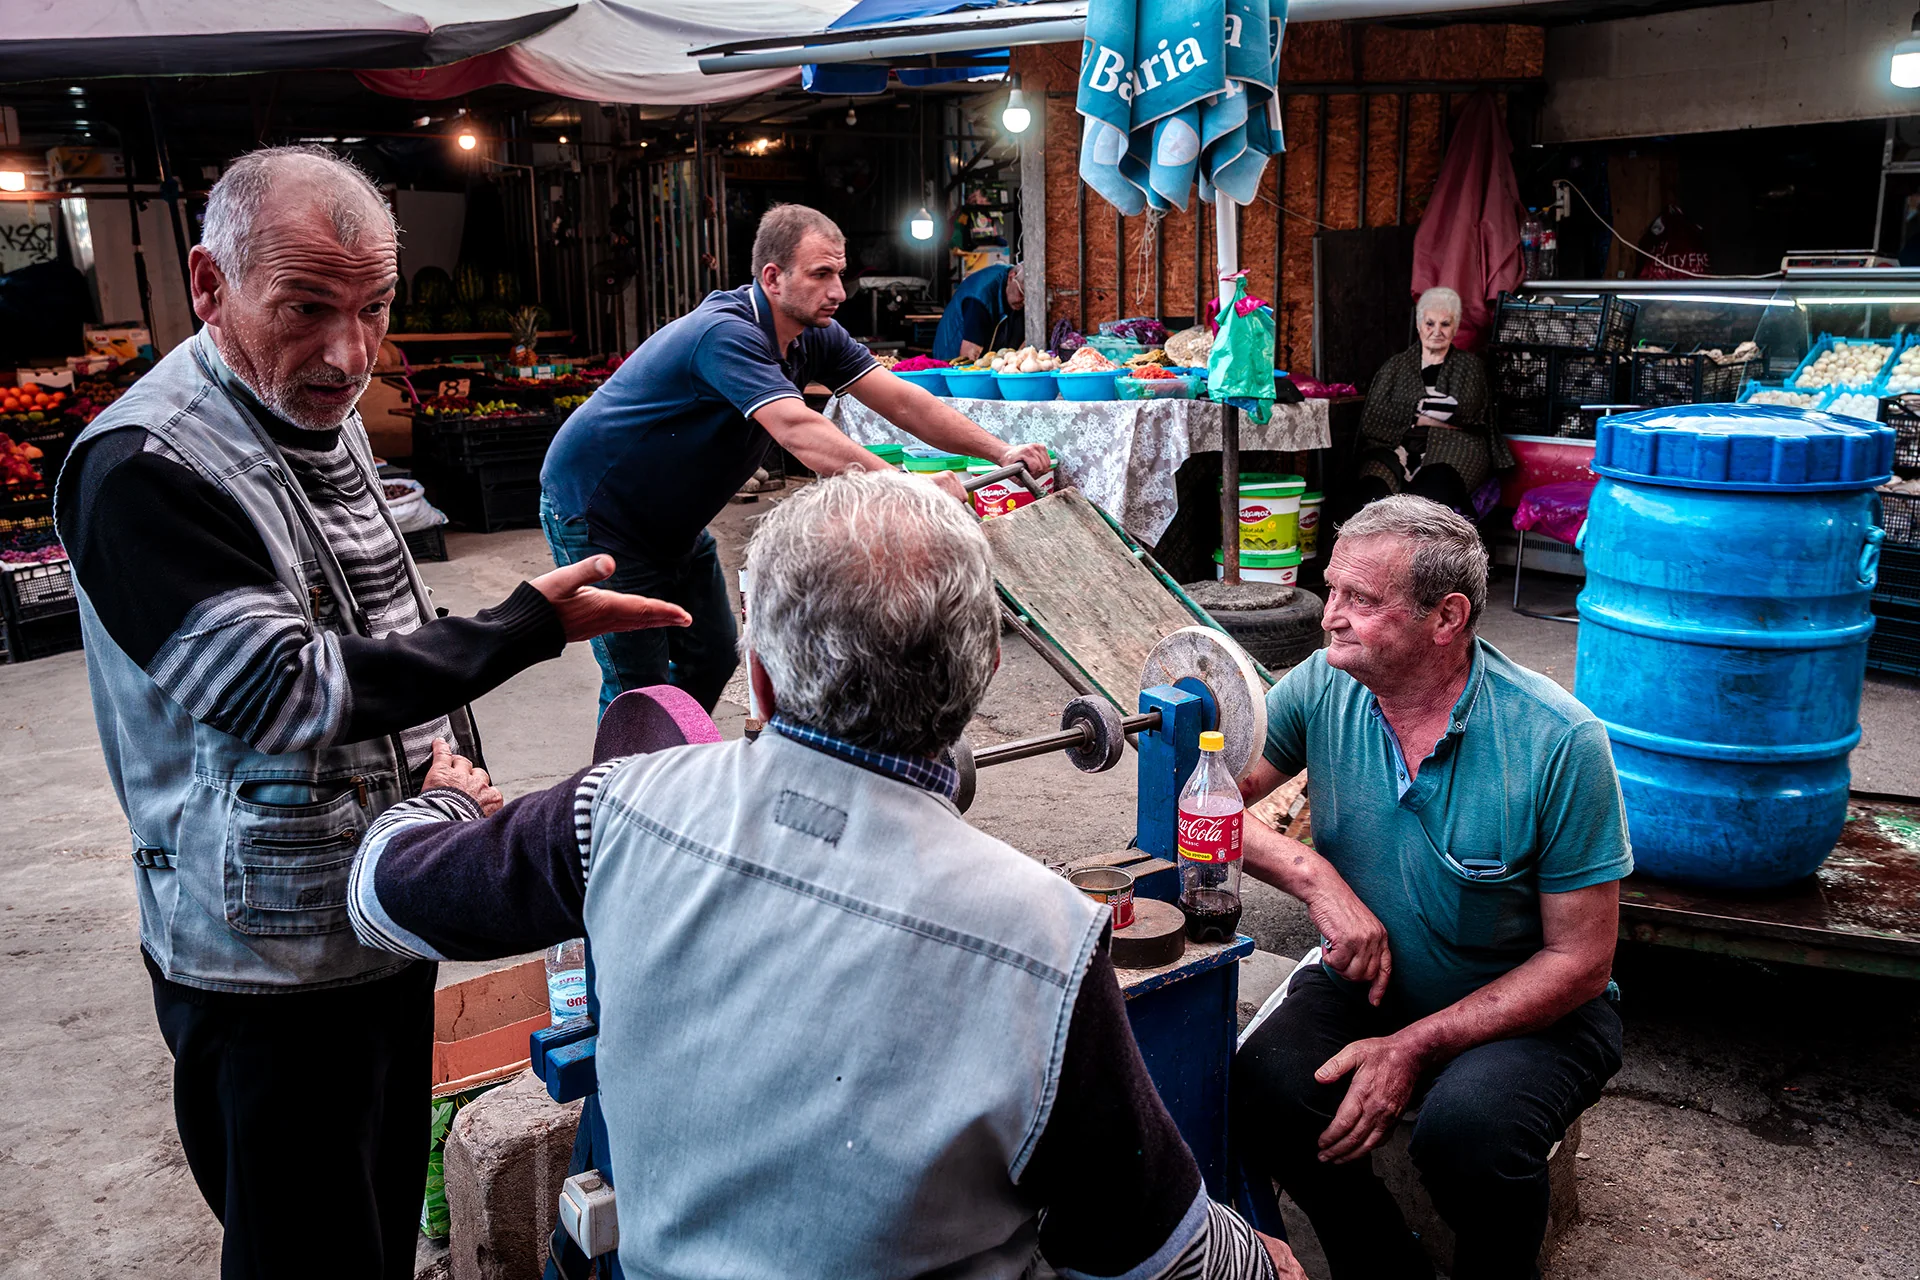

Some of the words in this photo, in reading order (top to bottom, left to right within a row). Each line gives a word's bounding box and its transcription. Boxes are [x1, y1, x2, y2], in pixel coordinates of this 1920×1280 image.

[1088, 36, 1208, 107] Baria
[1240, 509, 1269, 518] akamoz
[1178, 817, 1227, 841] ca-Cola
